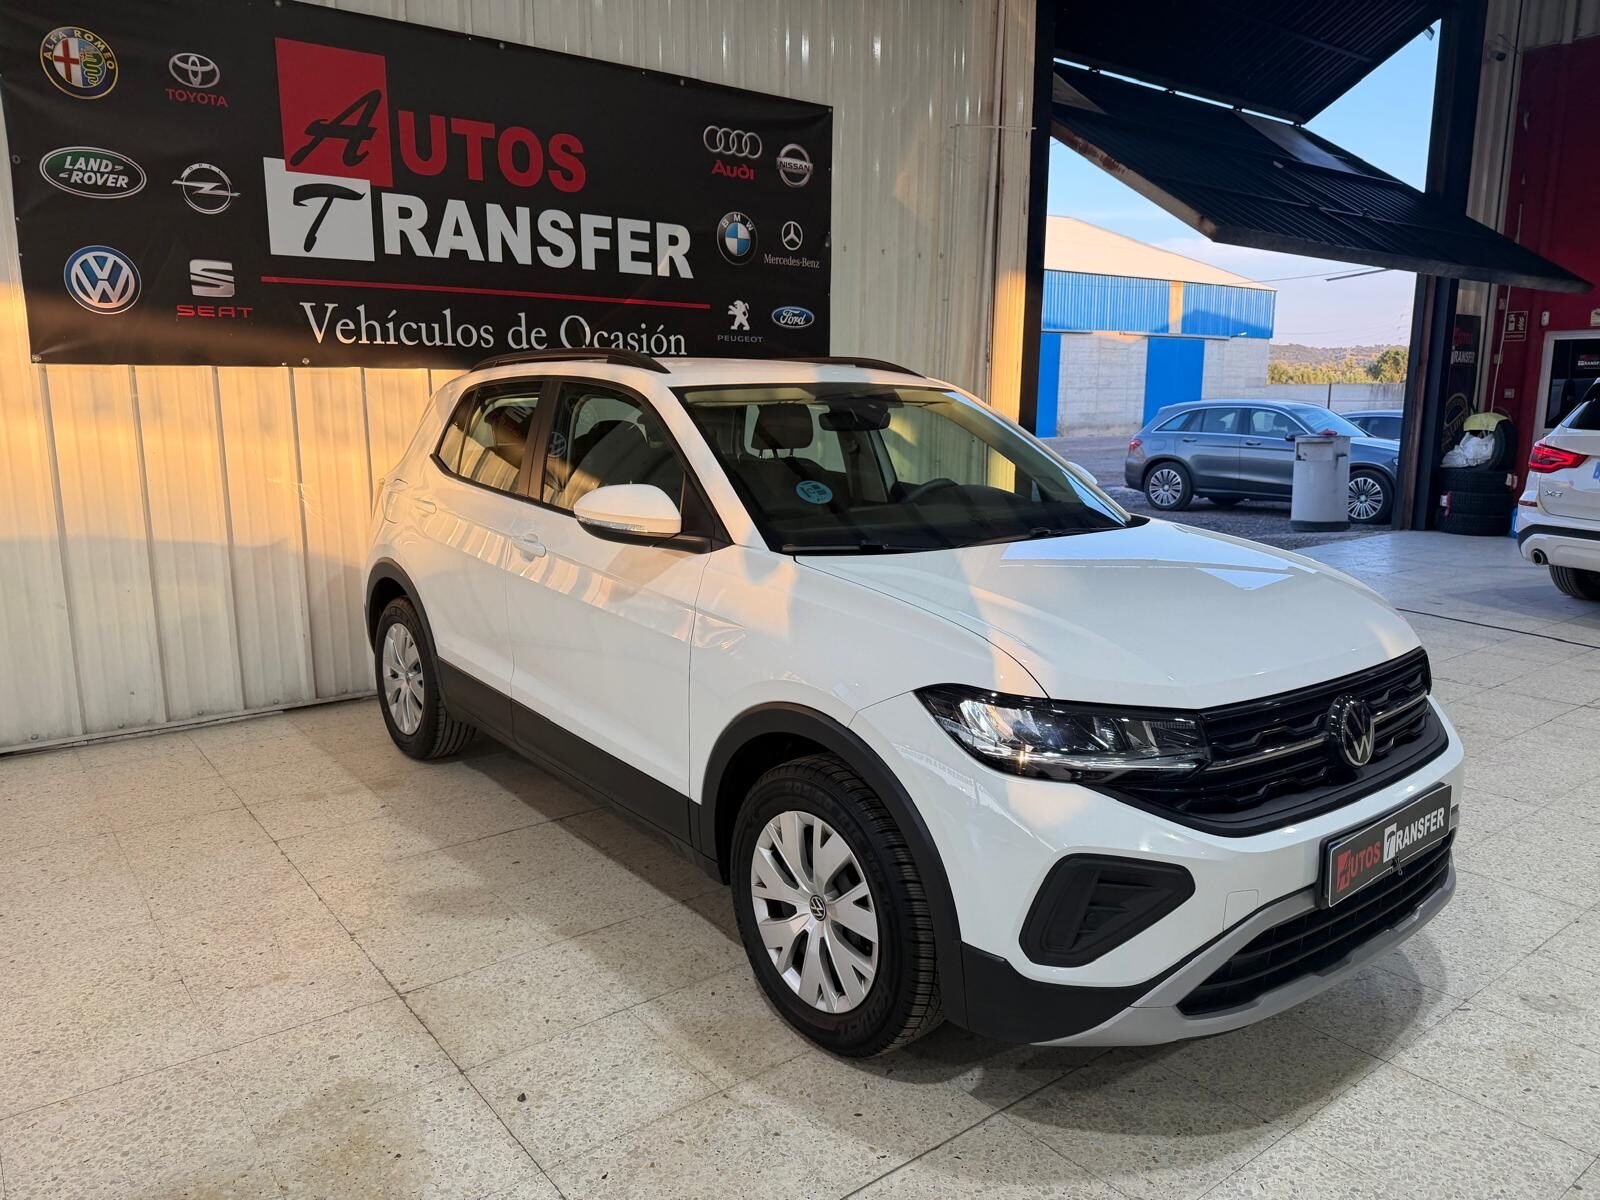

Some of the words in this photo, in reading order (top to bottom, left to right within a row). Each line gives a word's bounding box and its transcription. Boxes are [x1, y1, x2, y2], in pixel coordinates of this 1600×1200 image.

[43, 31, 67, 60] ALFA
[73, 29, 115, 70] ROMEO
[165, 88, 229, 108] TOYOTA
[289, 89, 587, 193] AUTOS
[64, 154, 113, 173] LAND
[711, 159, 756, 180] Audi
[778, 159, 811, 172] NISSAN
[69, 170, 130, 189] ROVER
[292, 182, 695, 280] TRANSFER
[720, 213, 755, 232] BMW
[763, 253, 821, 269] Mercedes-Benz
[176, 304, 253, 318] SEAT
[780, 309, 806, 326] Ford
[300, 301, 495, 349] Vehículos
[507, 312, 548, 350] de
[559, 314, 688, 356] Ocasión
[717, 334, 764, 344] PEUGEOT
[1337, 842, 1381, 892] AUTOS
[1383, 808, 1445, 863] TRANSFER
